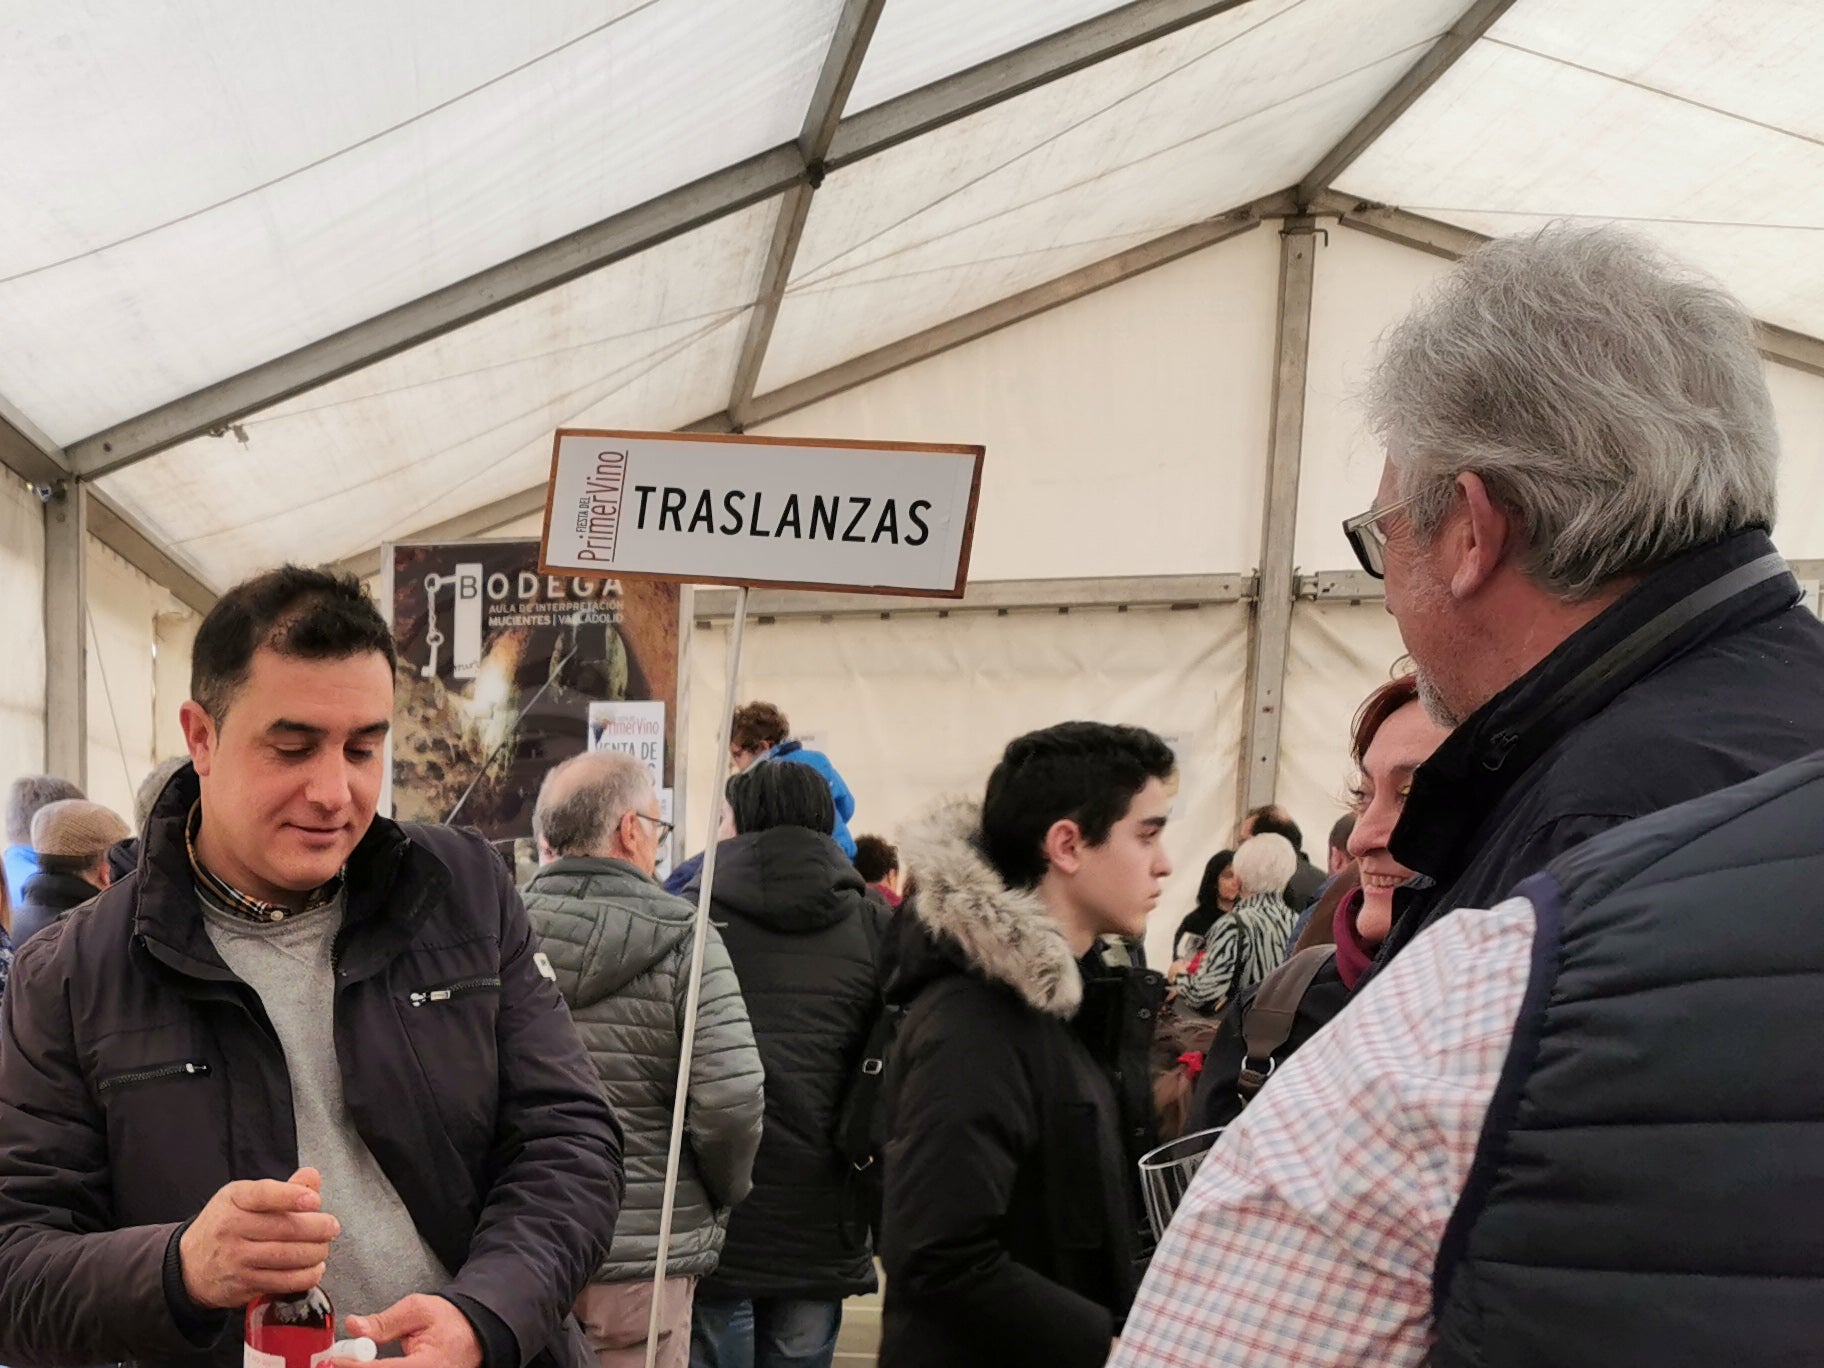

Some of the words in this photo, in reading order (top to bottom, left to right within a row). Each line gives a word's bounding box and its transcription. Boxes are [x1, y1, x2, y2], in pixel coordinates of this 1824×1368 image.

[577, 451, 624, 562] PrimerVino
[633, 484, 933, 547] TRASLANZAS
[459, 571, 625, 600] BODEGA
[488, 603, 518, 614] AULA
[518, 602, 534, 613] DE
[488, 614, 552, 627] MUCIENTES
[558, 613, 625, 626] VALLADOLID
[641, 741, 658, 761] DE
